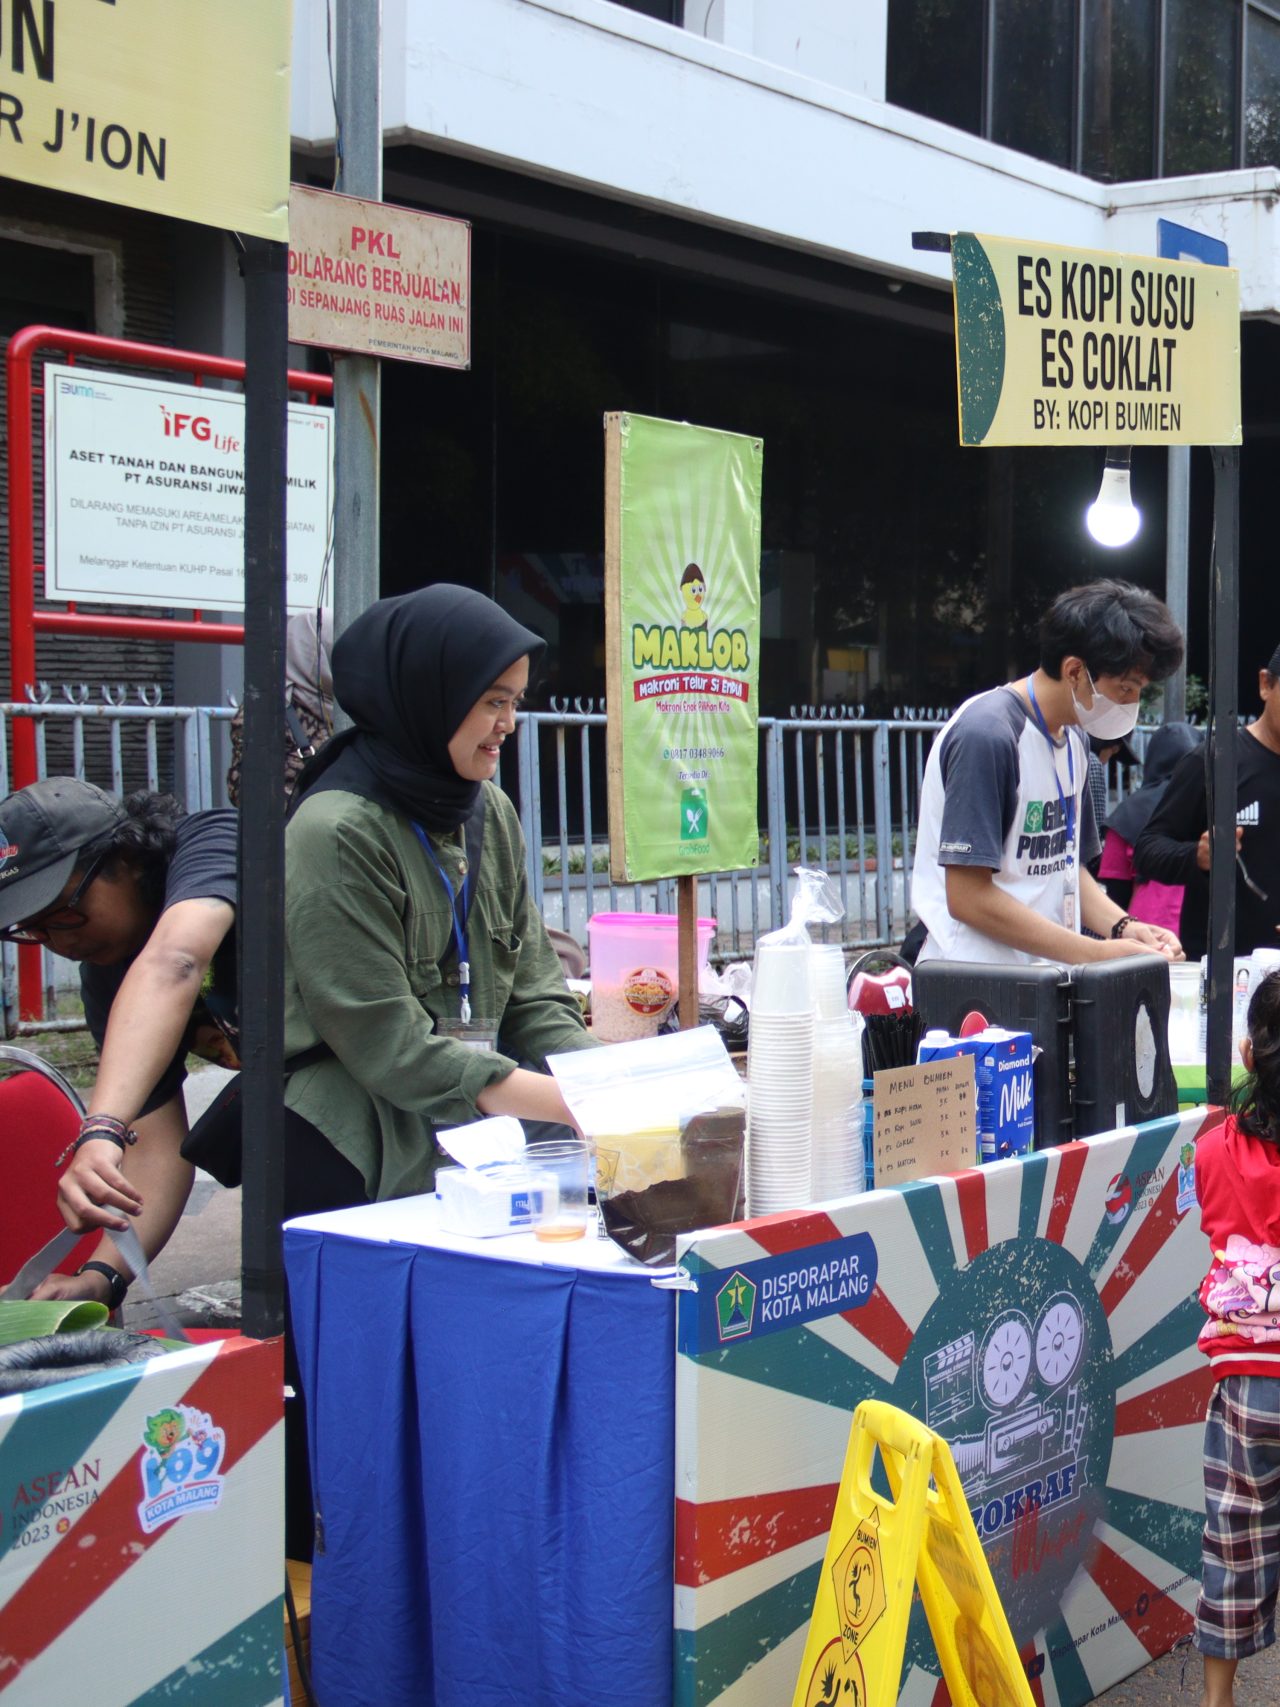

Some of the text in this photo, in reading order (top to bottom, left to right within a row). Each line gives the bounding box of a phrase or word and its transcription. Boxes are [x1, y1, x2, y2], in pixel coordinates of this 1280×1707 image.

[0, 0, 55, 83] N
[351, 226, 401, 259] PKL
[288, 250, 461, 305] DILARANG BERJUALAN
[1017, 255, 1195, 331] ES KOPI SUSU
[300, 289, 371, 318] SEPANJANG
[375, 303, 405, 324] RUAS
[409, 310, 445, 331] JALAN
[450, 316, 464, 333] INI
[1040, 327, 1177, 393] ES COKLAT
[1033, 398, 1181, 432] BY: KOPI BUMIEN
[213, 434, 240, 455] Life
[69, 449, 105, 464] ASET
[110, 454, 154, 470] TANAH
[159, 461, 186, 473] DAN
[191, 465, 245, 481] BANGUN
[125, 473, 141, 485] PT
[145, 475, 213, 492] ASURANSI
[70, 497, 124, 514] DILARANG
[126, 504, 181, 519] MEMASUKI
[182, 510, 245, 526] AREA/MELAK
[115, 517, 152, 530] TANPA
[171, 524, 185, 533] PT
[187, 525, 236, 539] ASURANSI
[79, 554, 129, 571] Melanggar
[131, 560, 178, 572] Ketentuan
[179, 563, 207, 575] KUHP
[632, 624, 750, 672] MAKLOR
[998, 1053, 1030, 1073] Diamond
[889, 1077, 915, 1095] MENU
[1000, 1070, 1032, 1128] Milk
[1135, 1166, 1165, 1186] ASEAN
[762, 1255, 859, 1300] DISPORAPAR
[762, 1274, 869, 1323] KOTA MALANG
[12, 1458, 101, 1510] ASEAN
[12, 1489, 100, 1531] INDONESIA
[146, 1485, 219, 1522] KOTA MALANG
[12, 1524, 51, 1551] 2023
[856, 1529, 878, 1551] BUMIEN
[842, 1624, 859, 1646] ZONE
[1090, 1622, 1107, 1639] Kota
